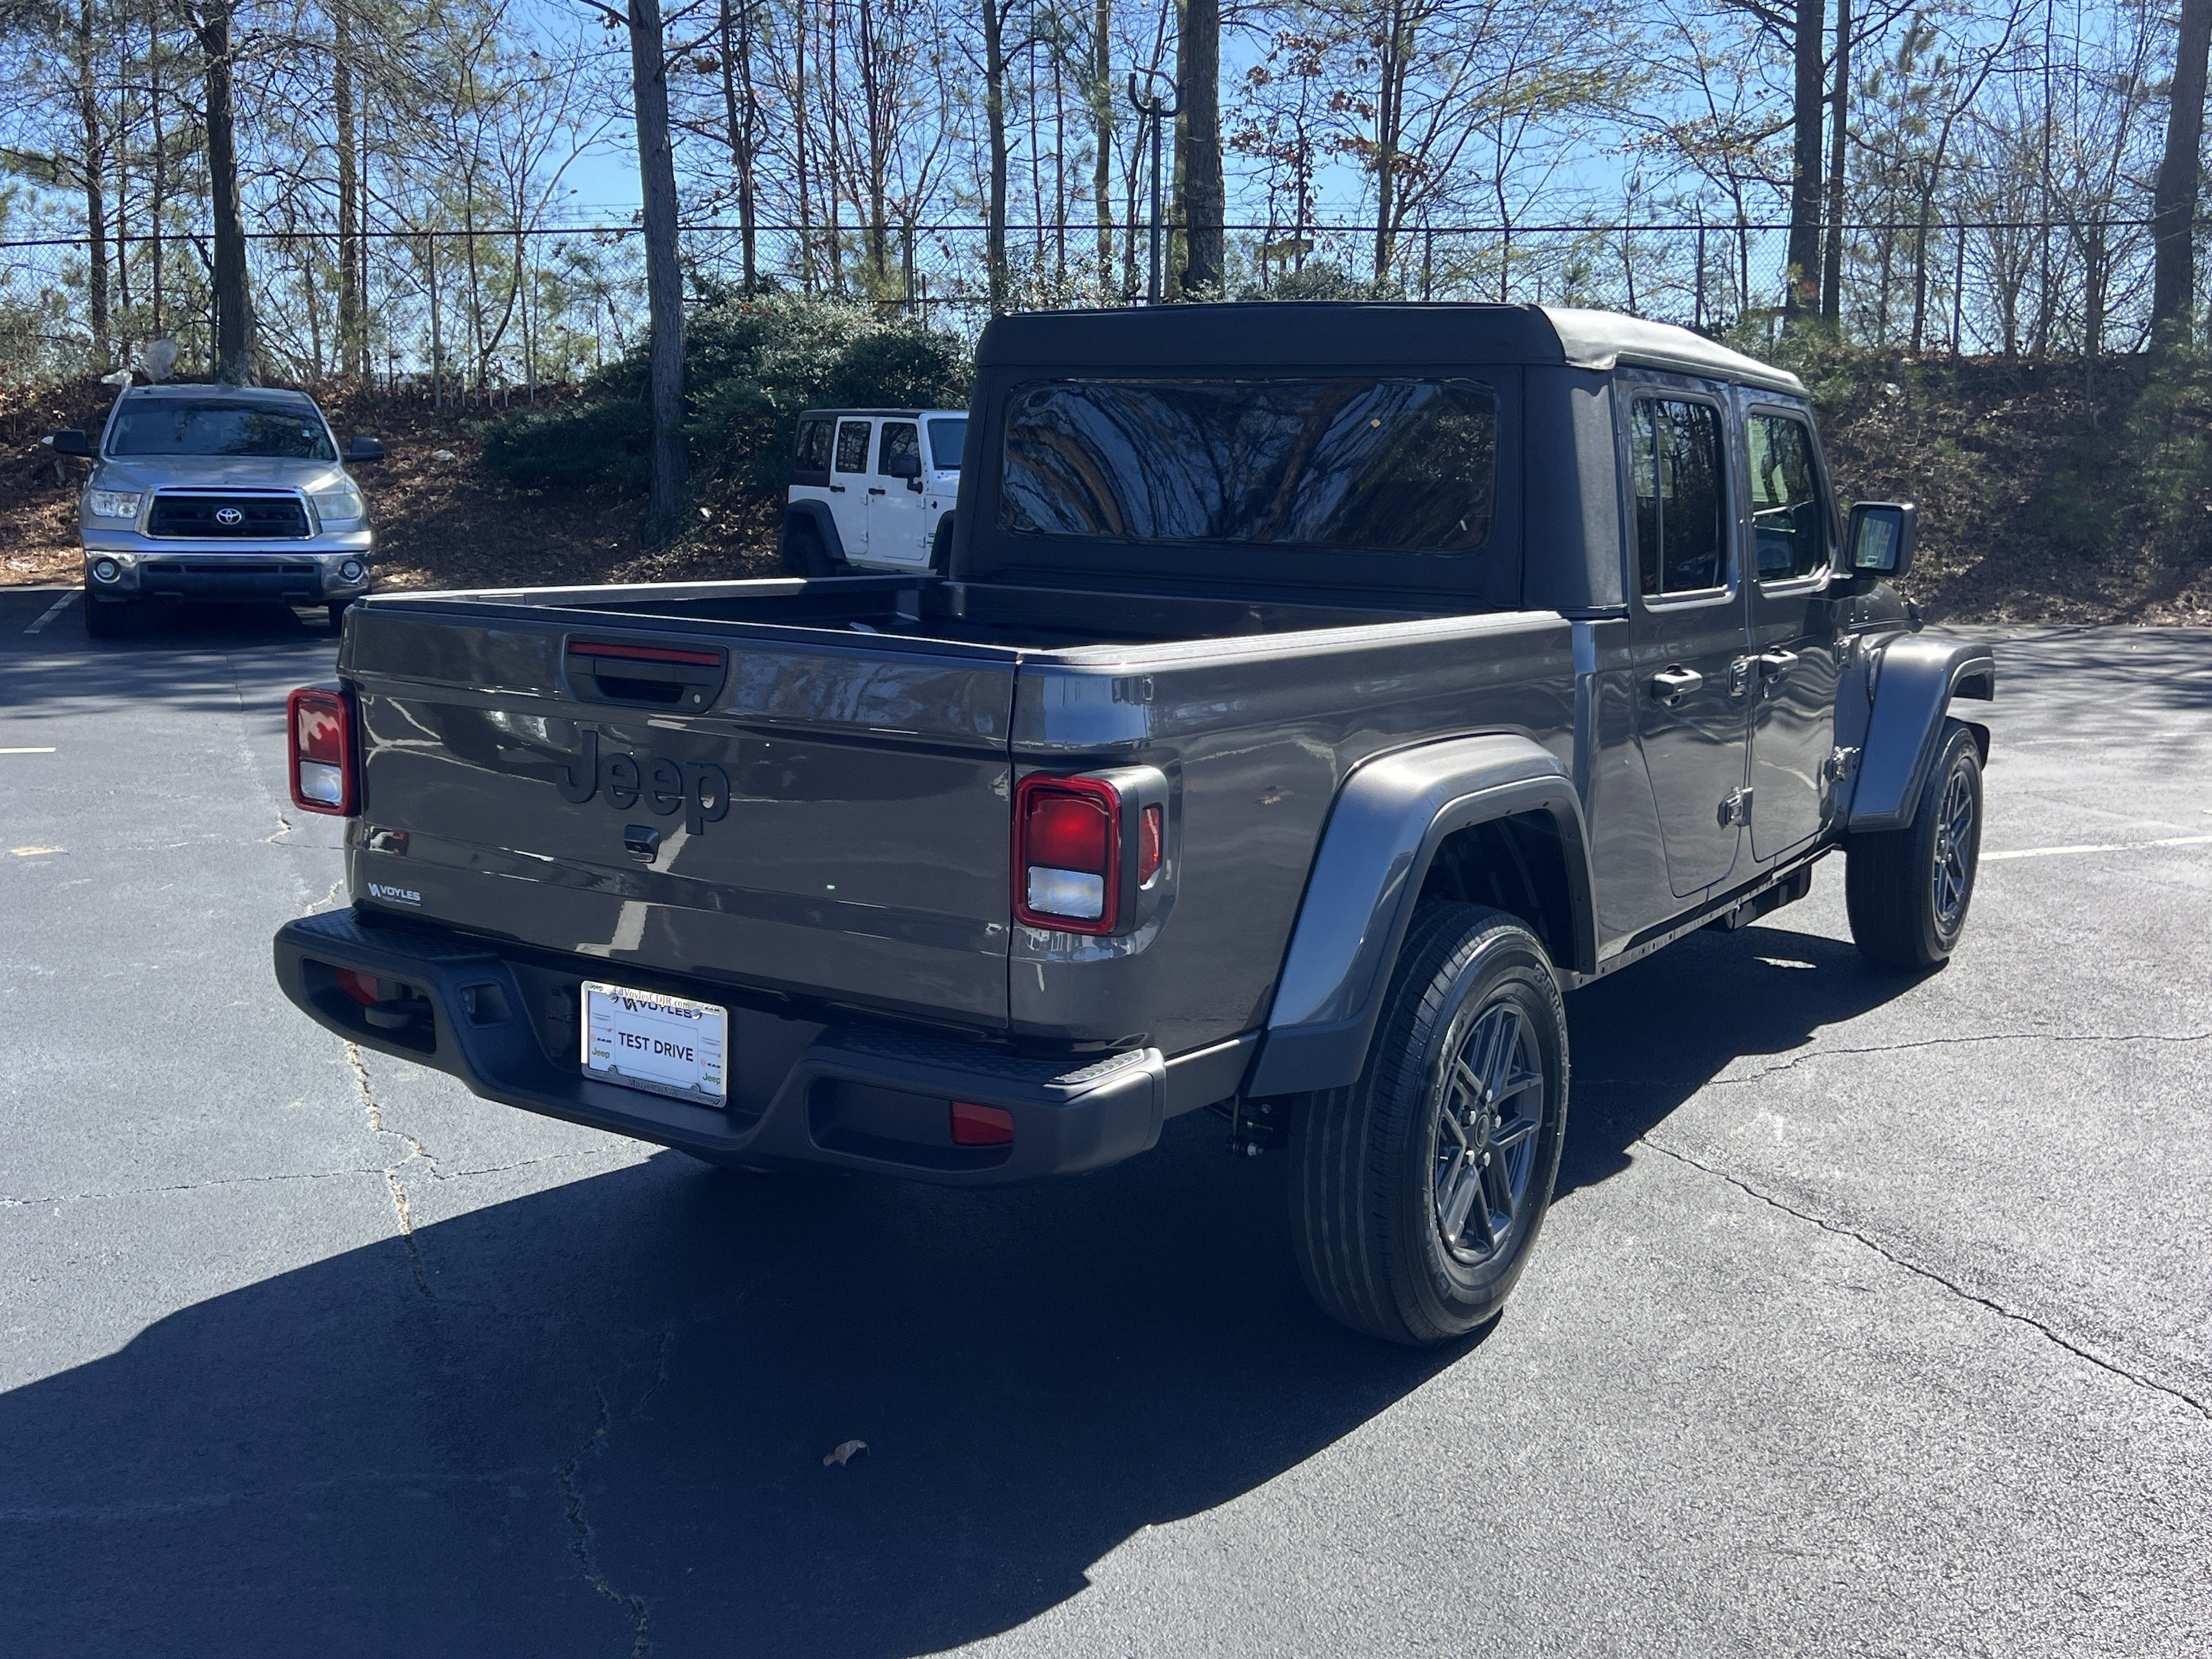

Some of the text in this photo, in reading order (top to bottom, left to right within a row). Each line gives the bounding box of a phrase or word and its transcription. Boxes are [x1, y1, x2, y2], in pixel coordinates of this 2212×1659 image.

[555, 729, 731, 836] Jeep
[380, 884, 421, 901] VOYLES
[591, 1047, 610, 1059] Jeep
[618, 1031, 693, 1063] TEST DRIVE
[702, 1073, 721, 1085] Jeep
